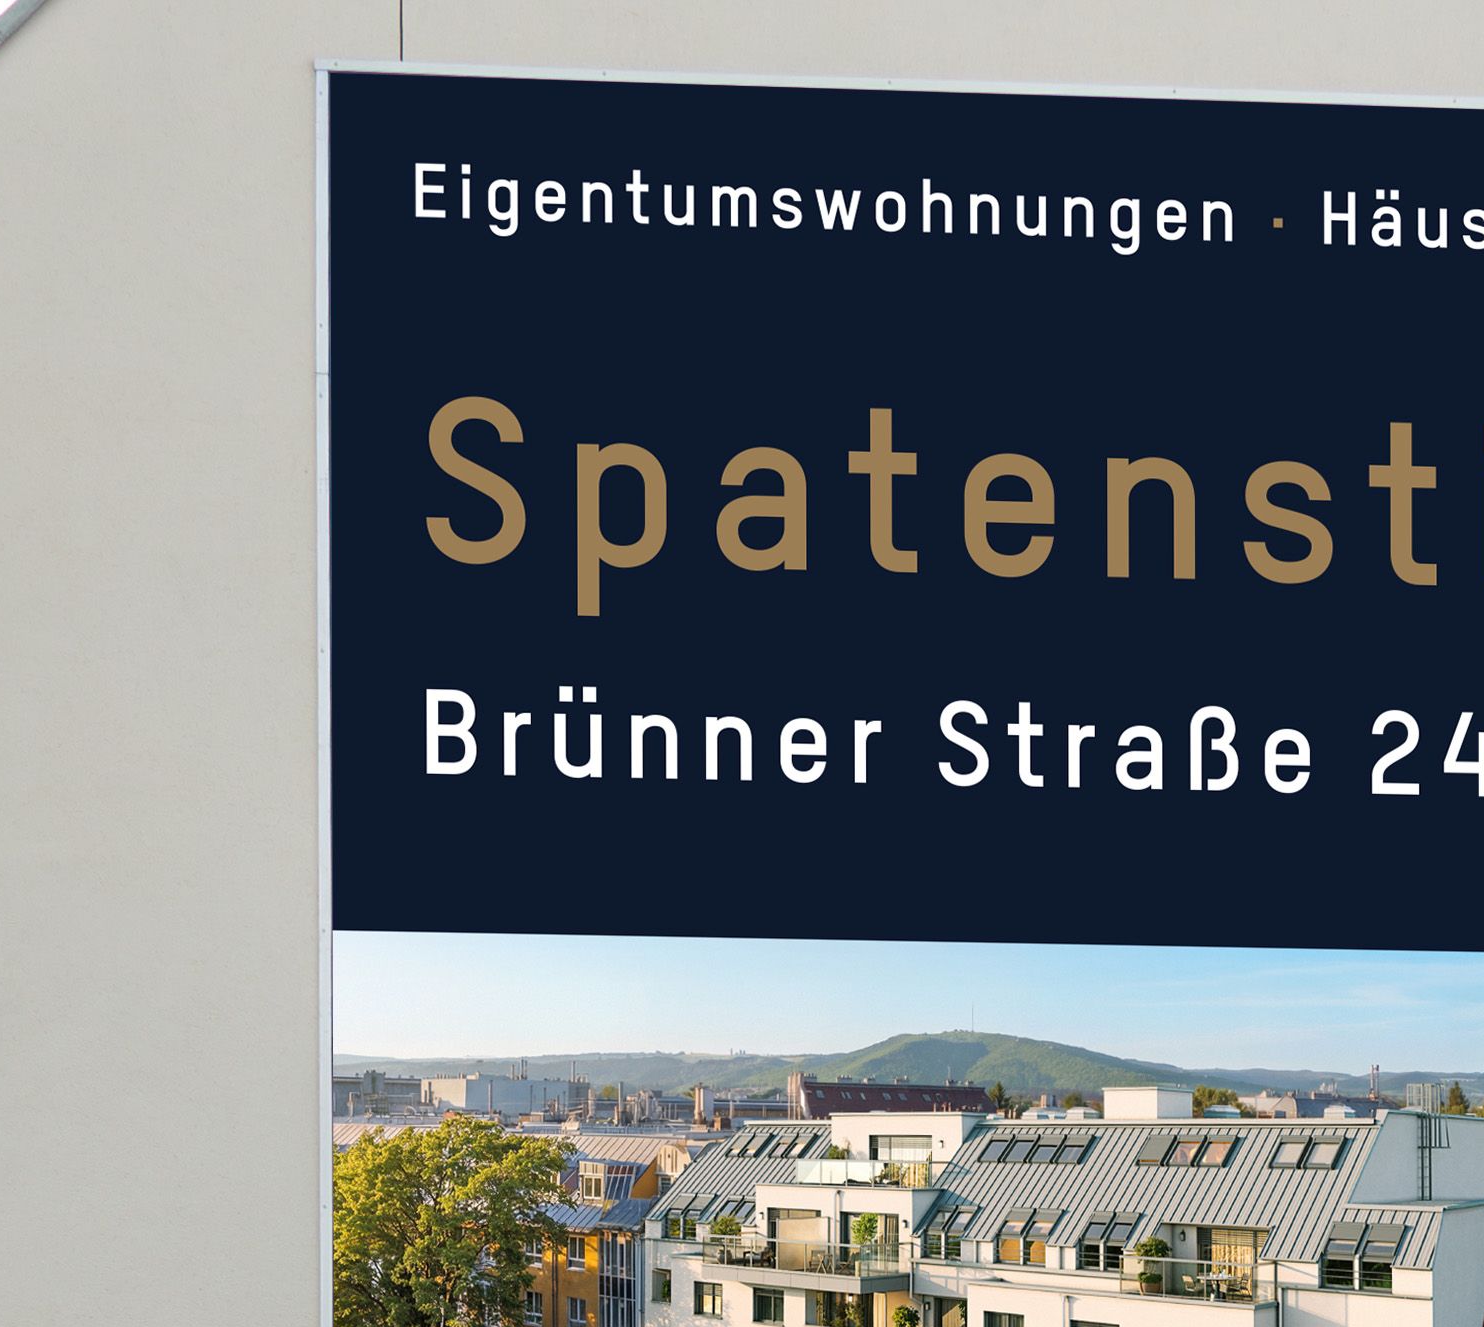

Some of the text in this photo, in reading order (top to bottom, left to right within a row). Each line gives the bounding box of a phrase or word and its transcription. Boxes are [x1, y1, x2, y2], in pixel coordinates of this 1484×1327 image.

[414, 162, 1233, 256] Eigentumswohnungen
[426, 685, 882, 784] Brünner
[938, 699, 1311, 794] Straße
